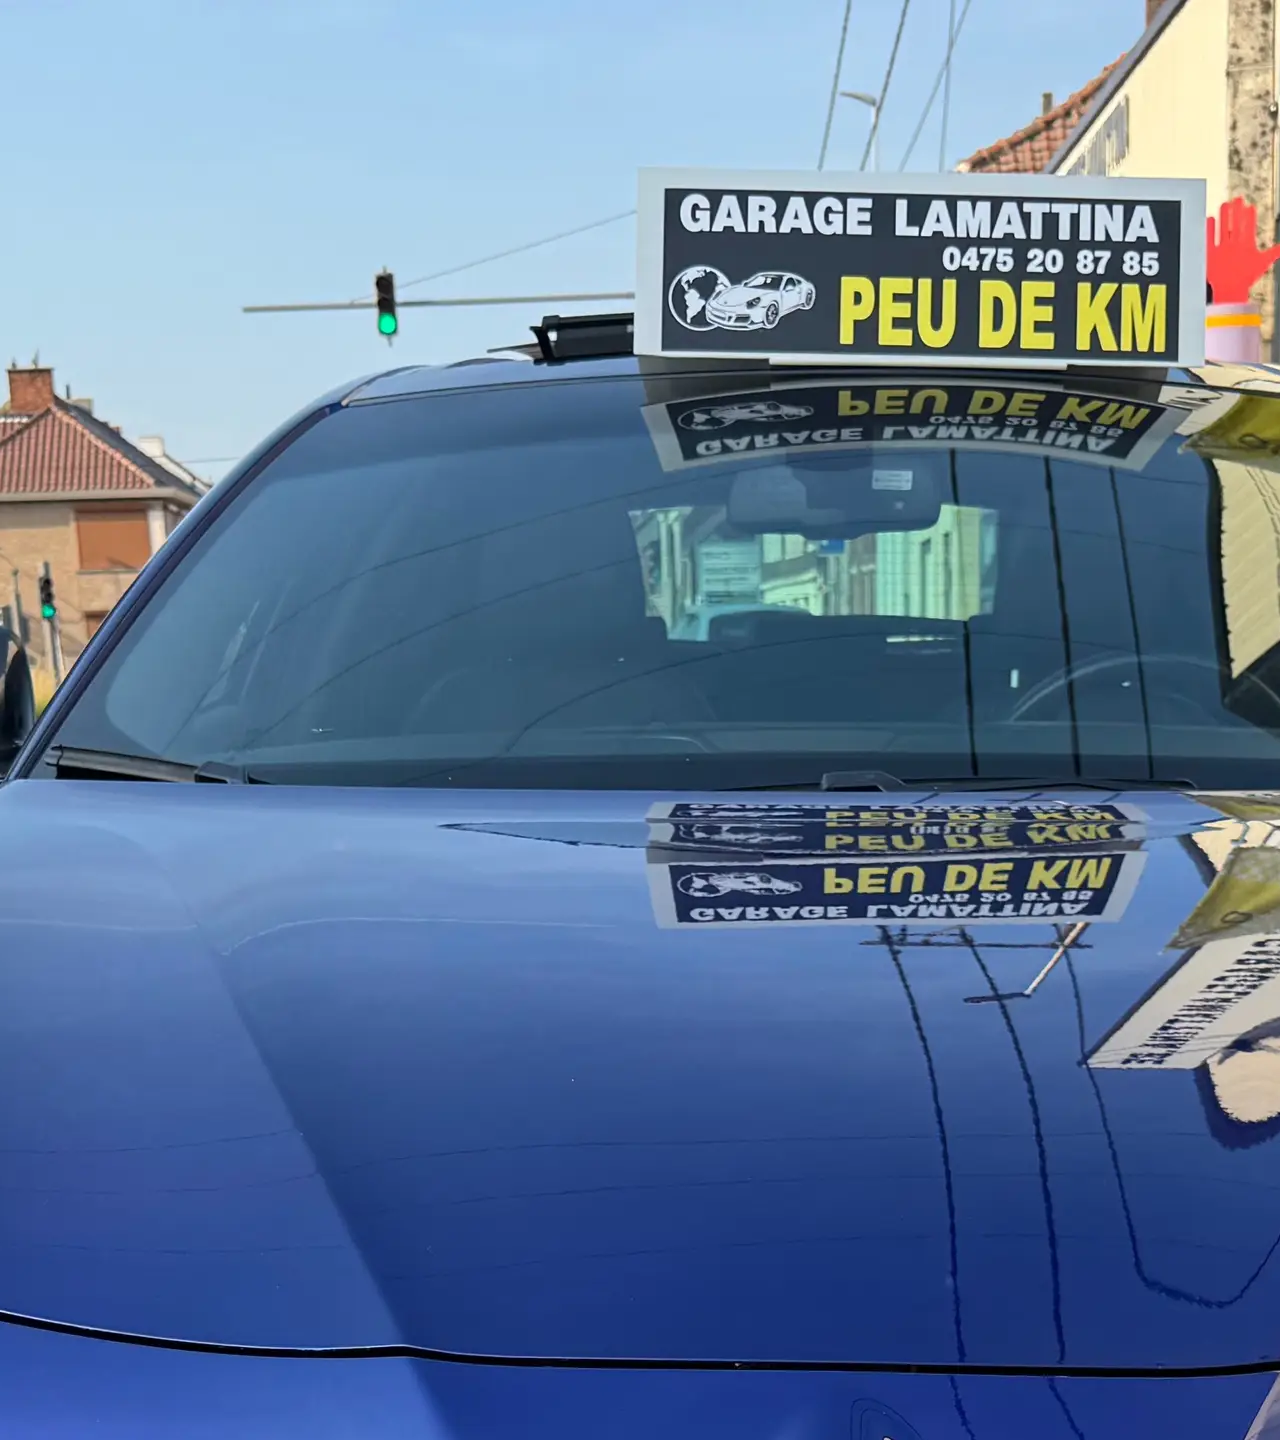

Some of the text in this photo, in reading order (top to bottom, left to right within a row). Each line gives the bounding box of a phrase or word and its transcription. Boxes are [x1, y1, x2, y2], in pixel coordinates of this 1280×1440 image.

[680, 193, 1160, 243] GARAGE LAMATTINA
[942, 246, 1160, 276] 0475 20 87 85
[841, 276, 1166, 353] PEU DE KM
